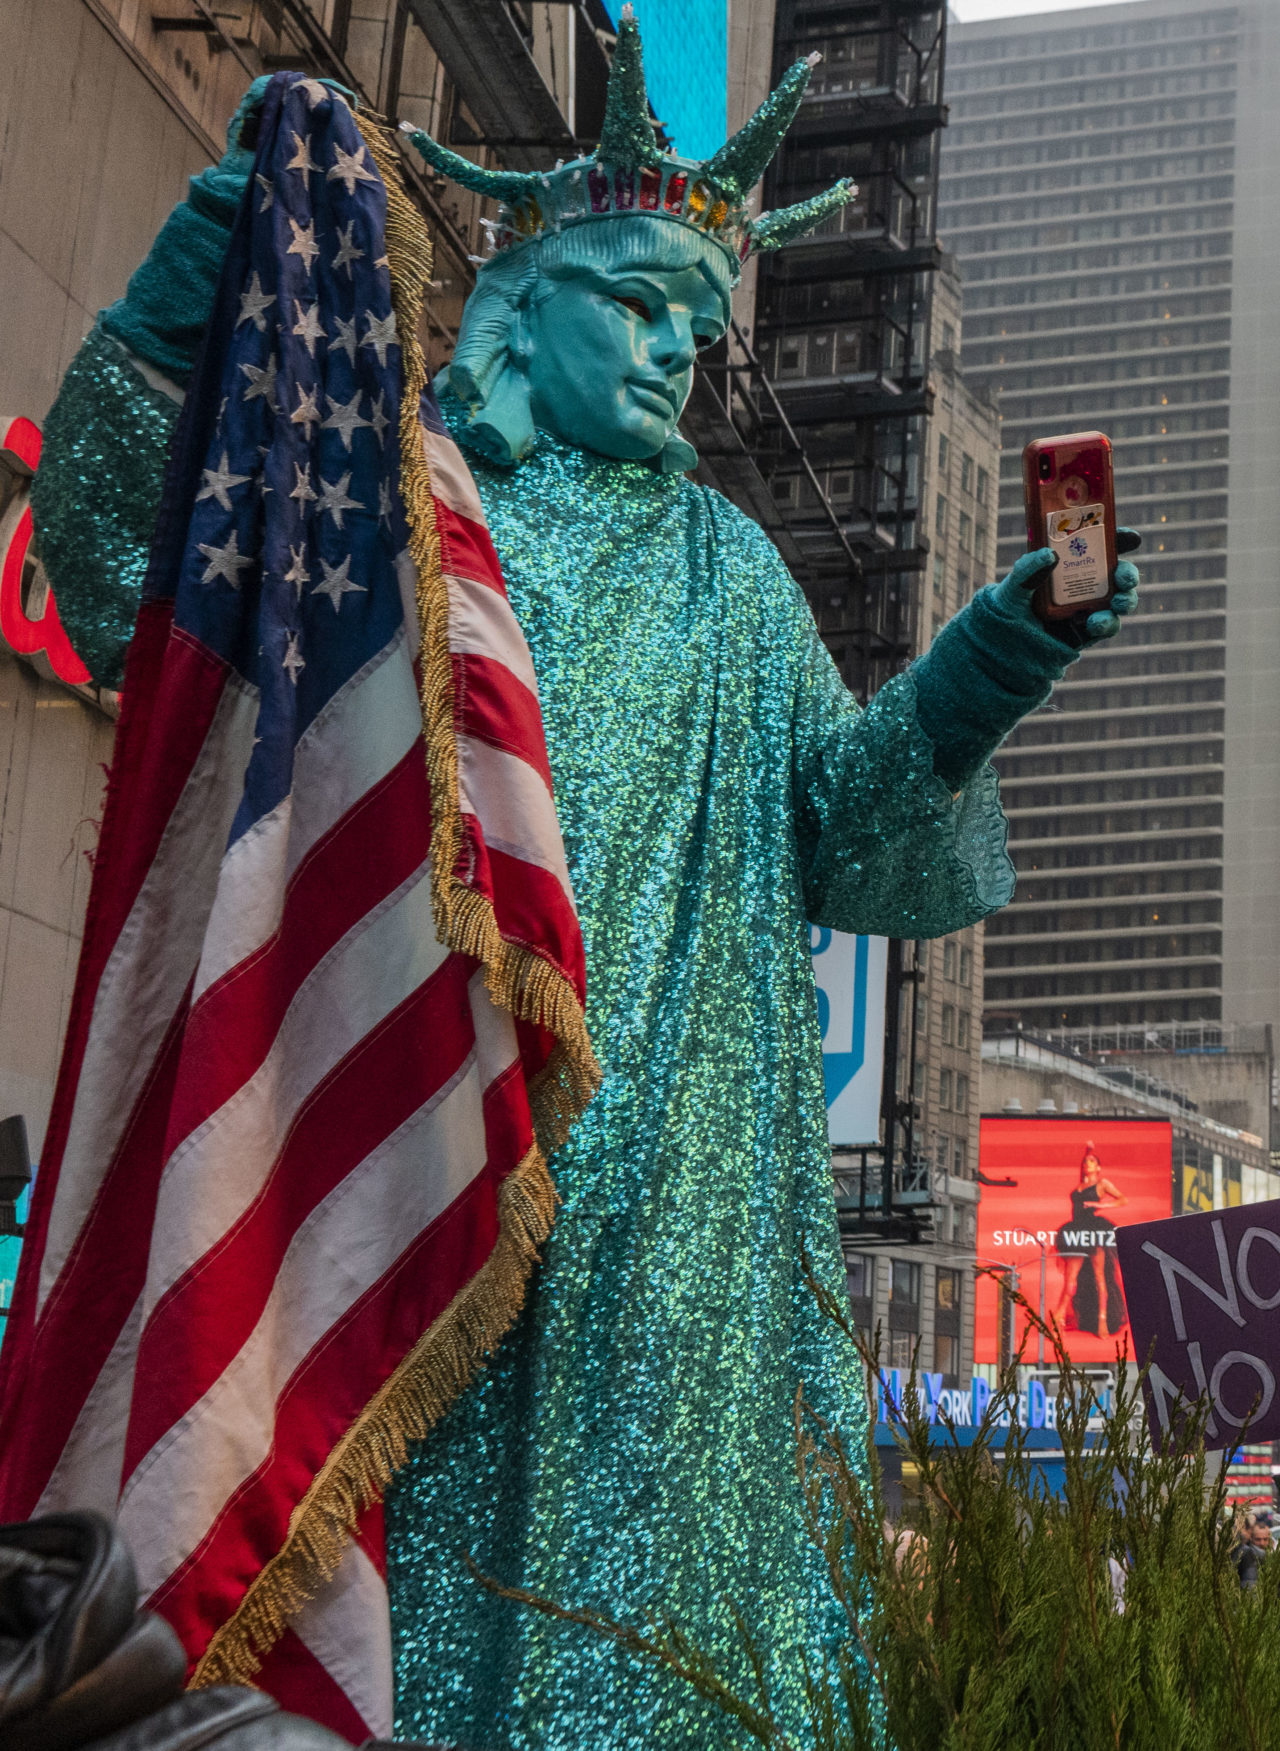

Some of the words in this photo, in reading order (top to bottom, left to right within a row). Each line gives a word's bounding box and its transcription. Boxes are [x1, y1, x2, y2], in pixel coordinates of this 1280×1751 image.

[1063, 557, 1096, 568] SmartRx
[993, 1230, 1058, 1246] STUART
[1063, 1230, 1117, 1247] WEITZ
[922, 1372, 972, 1426] YORK
[1147, 1340, 1277, 1442] NO
